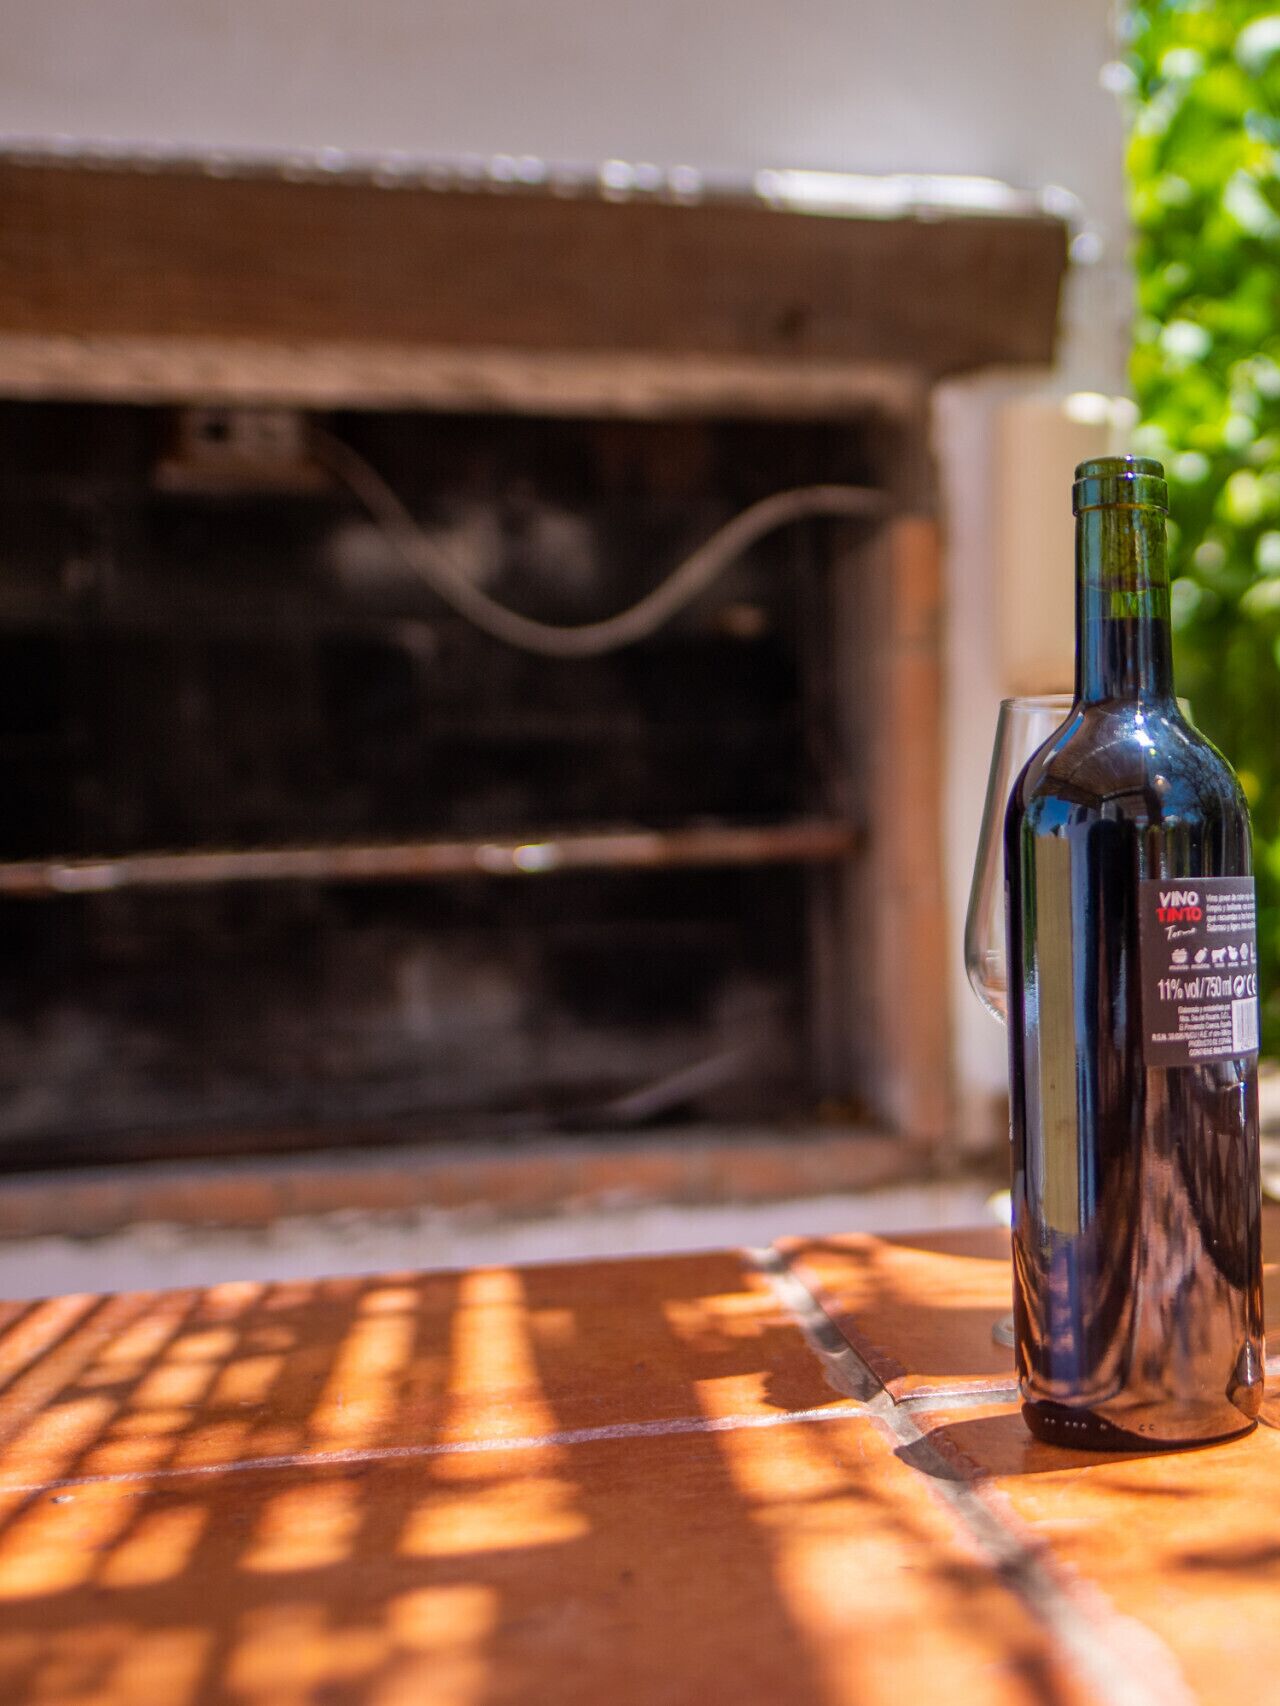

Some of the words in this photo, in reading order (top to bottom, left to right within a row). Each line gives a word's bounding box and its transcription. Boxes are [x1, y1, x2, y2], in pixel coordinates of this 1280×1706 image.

[1159, 890, 1199, 908] VINO
[1156, 907, 1202, 922] TINTO
[1157, 978, 1183, 1000] 11%
